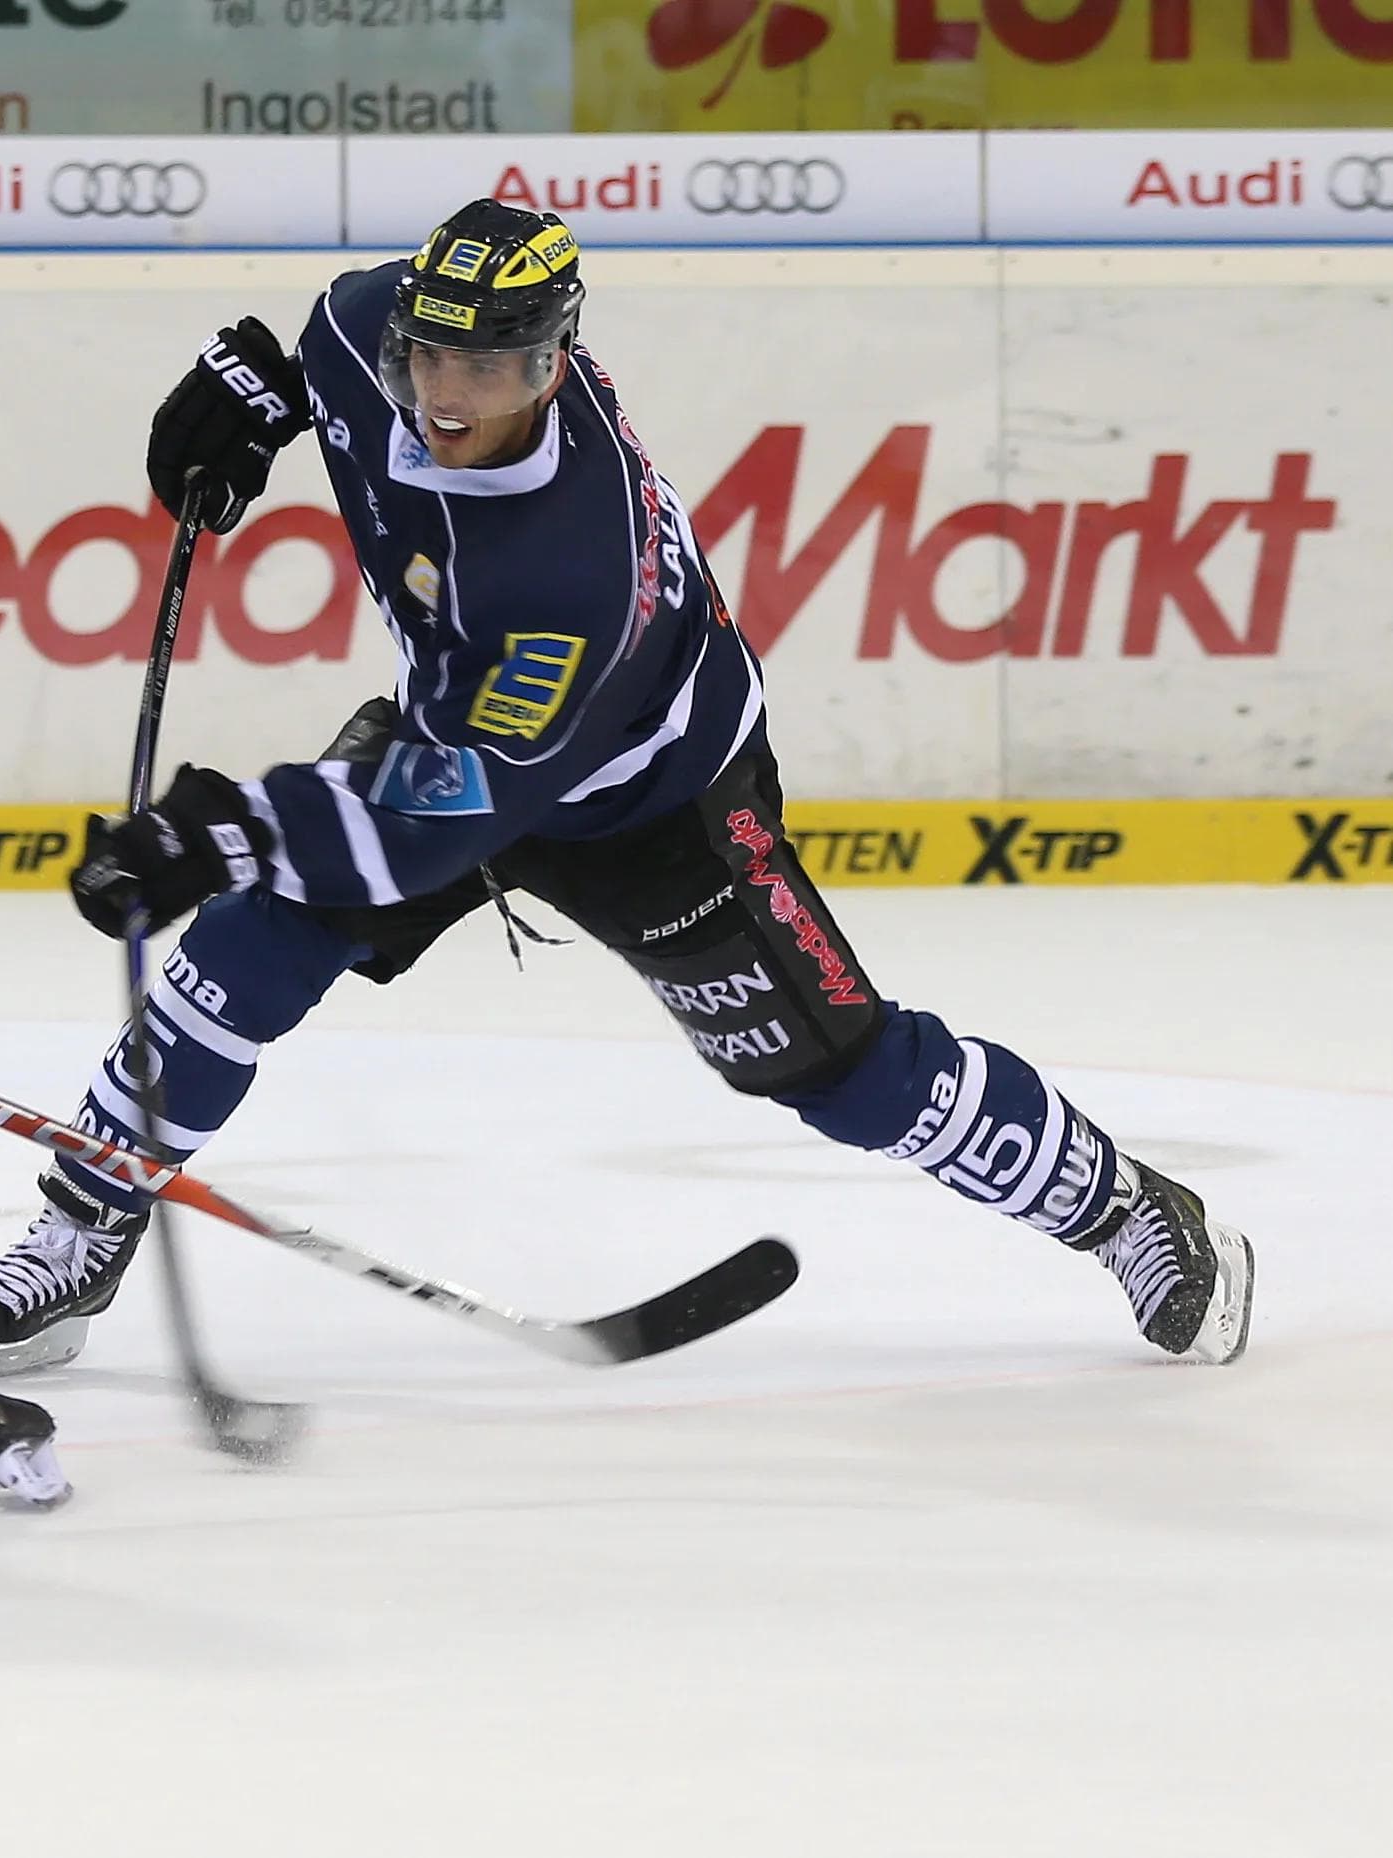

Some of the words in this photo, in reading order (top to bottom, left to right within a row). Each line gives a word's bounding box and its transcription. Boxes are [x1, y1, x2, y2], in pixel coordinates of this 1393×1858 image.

[202, 79, 498, 135] Ingolstadt
[490, 164, 663, 212] Audi
[1127, 159, 1306, 208] Audi
[421, 299, 468, 319] EDEKA
[687, 424, 1336, 663] Markt
[793, 904, 868, 1006] Media
[644, 960, 775, 1016] ERRN
[938, 1114, 1033, 1201] 15
